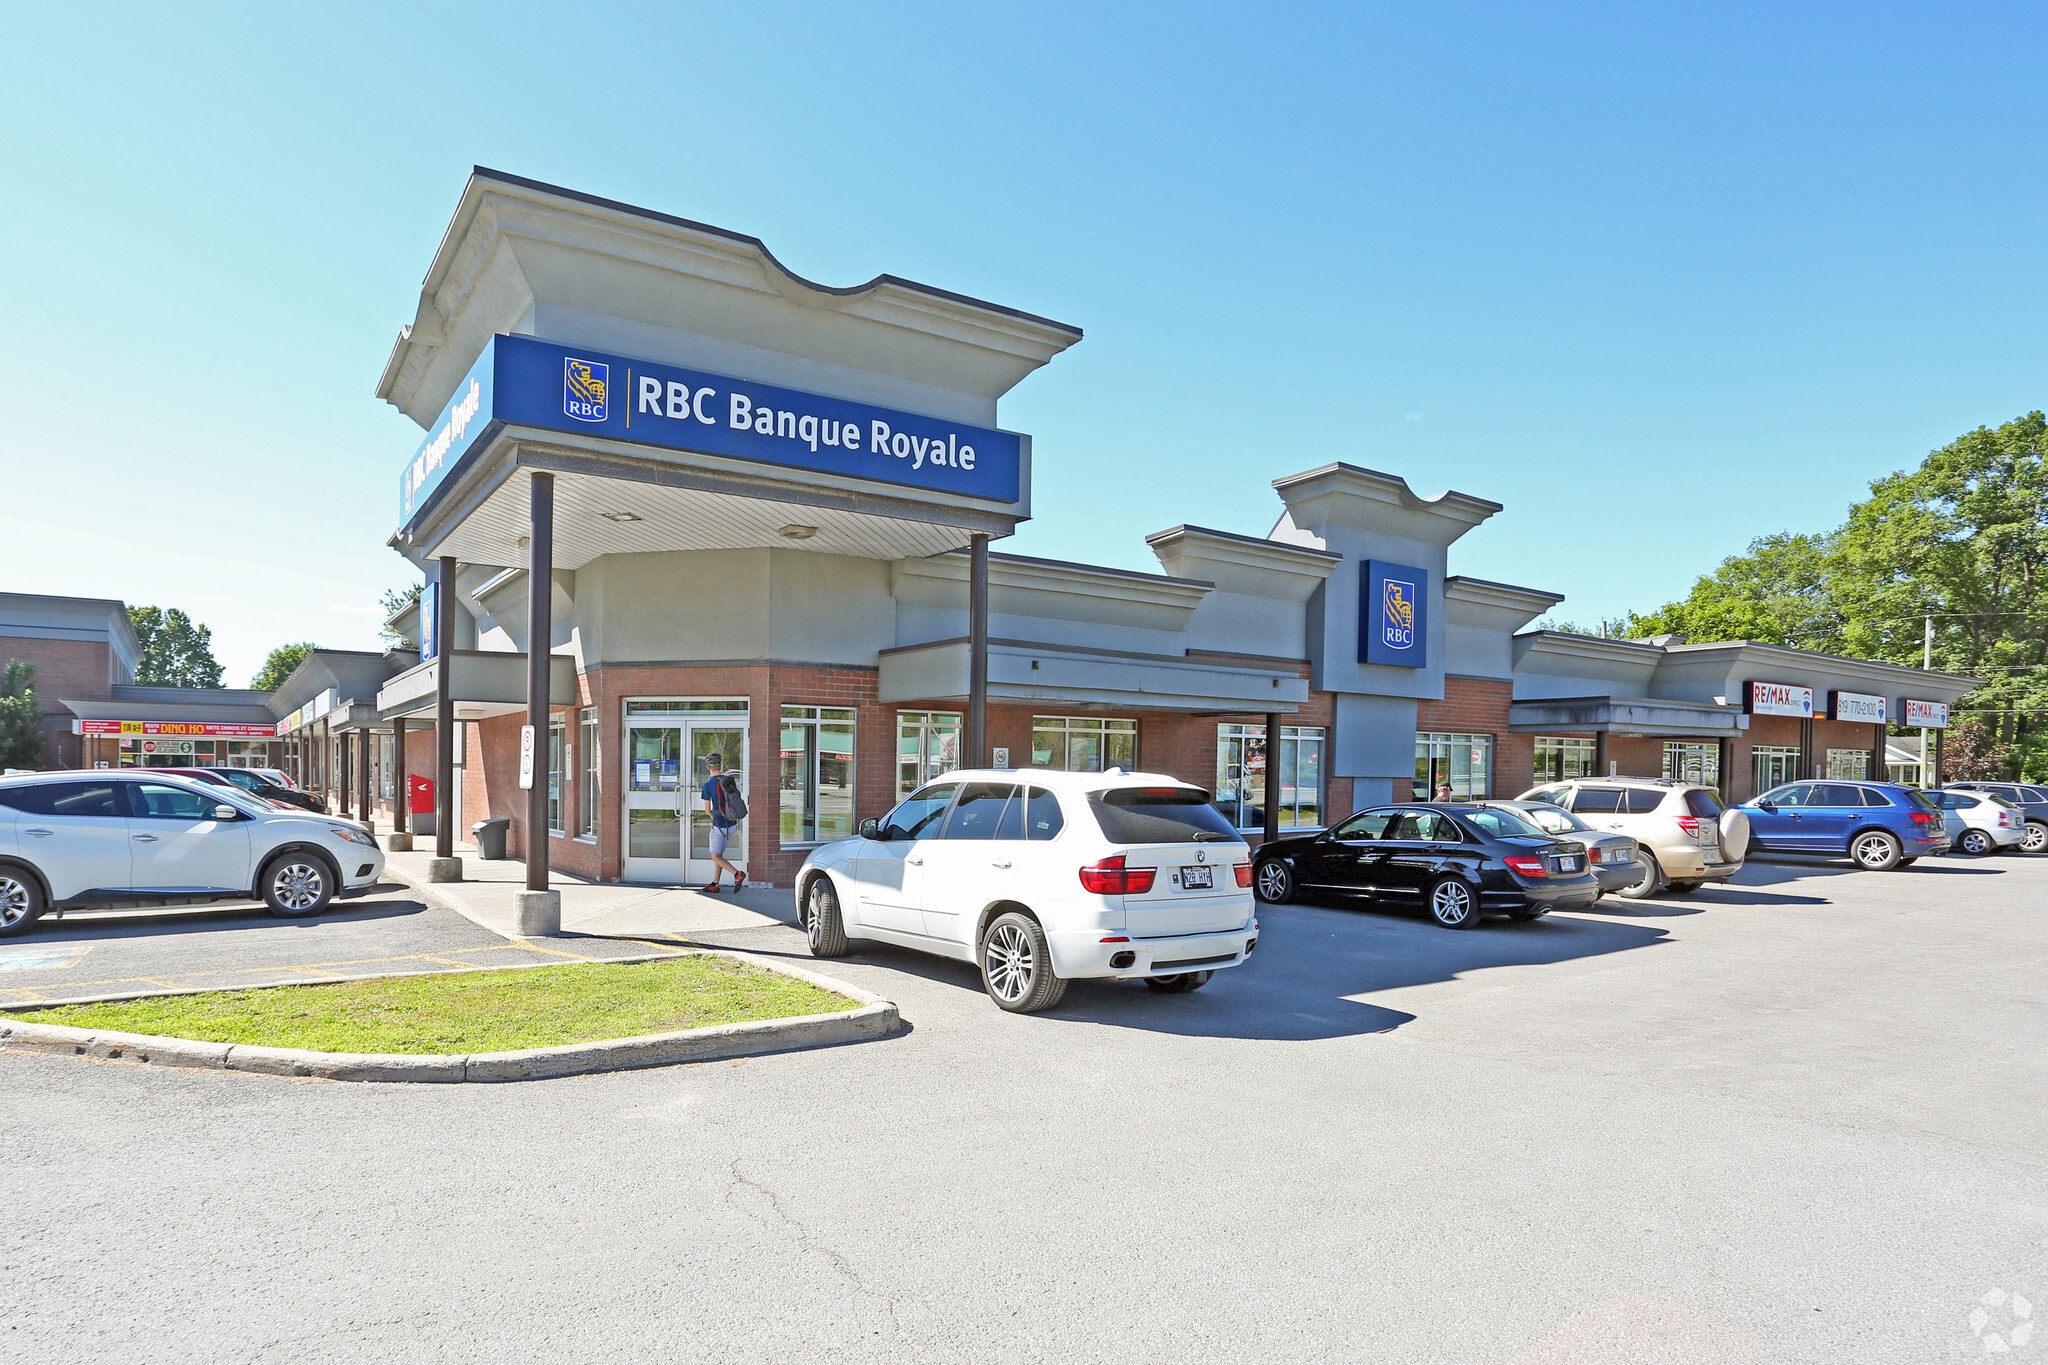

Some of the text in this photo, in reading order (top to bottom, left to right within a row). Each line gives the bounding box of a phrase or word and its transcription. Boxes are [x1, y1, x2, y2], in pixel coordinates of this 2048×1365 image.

[569, 400, 603, 418] RBC
[426, 422, 451, 468] Banque
[452, 377, 480, 442] Royale
[639, 375, 976, 471] RBC Banque Royale
[1386, 627, 1410, 644] RBC
[1754, 685, 1791, 705] RE/MAX
[1850, 700, 1877, 716] 770-2100
[1907, 702, 1932, 718] RE/MAX
[160, 723, 205, 734] DING HO
